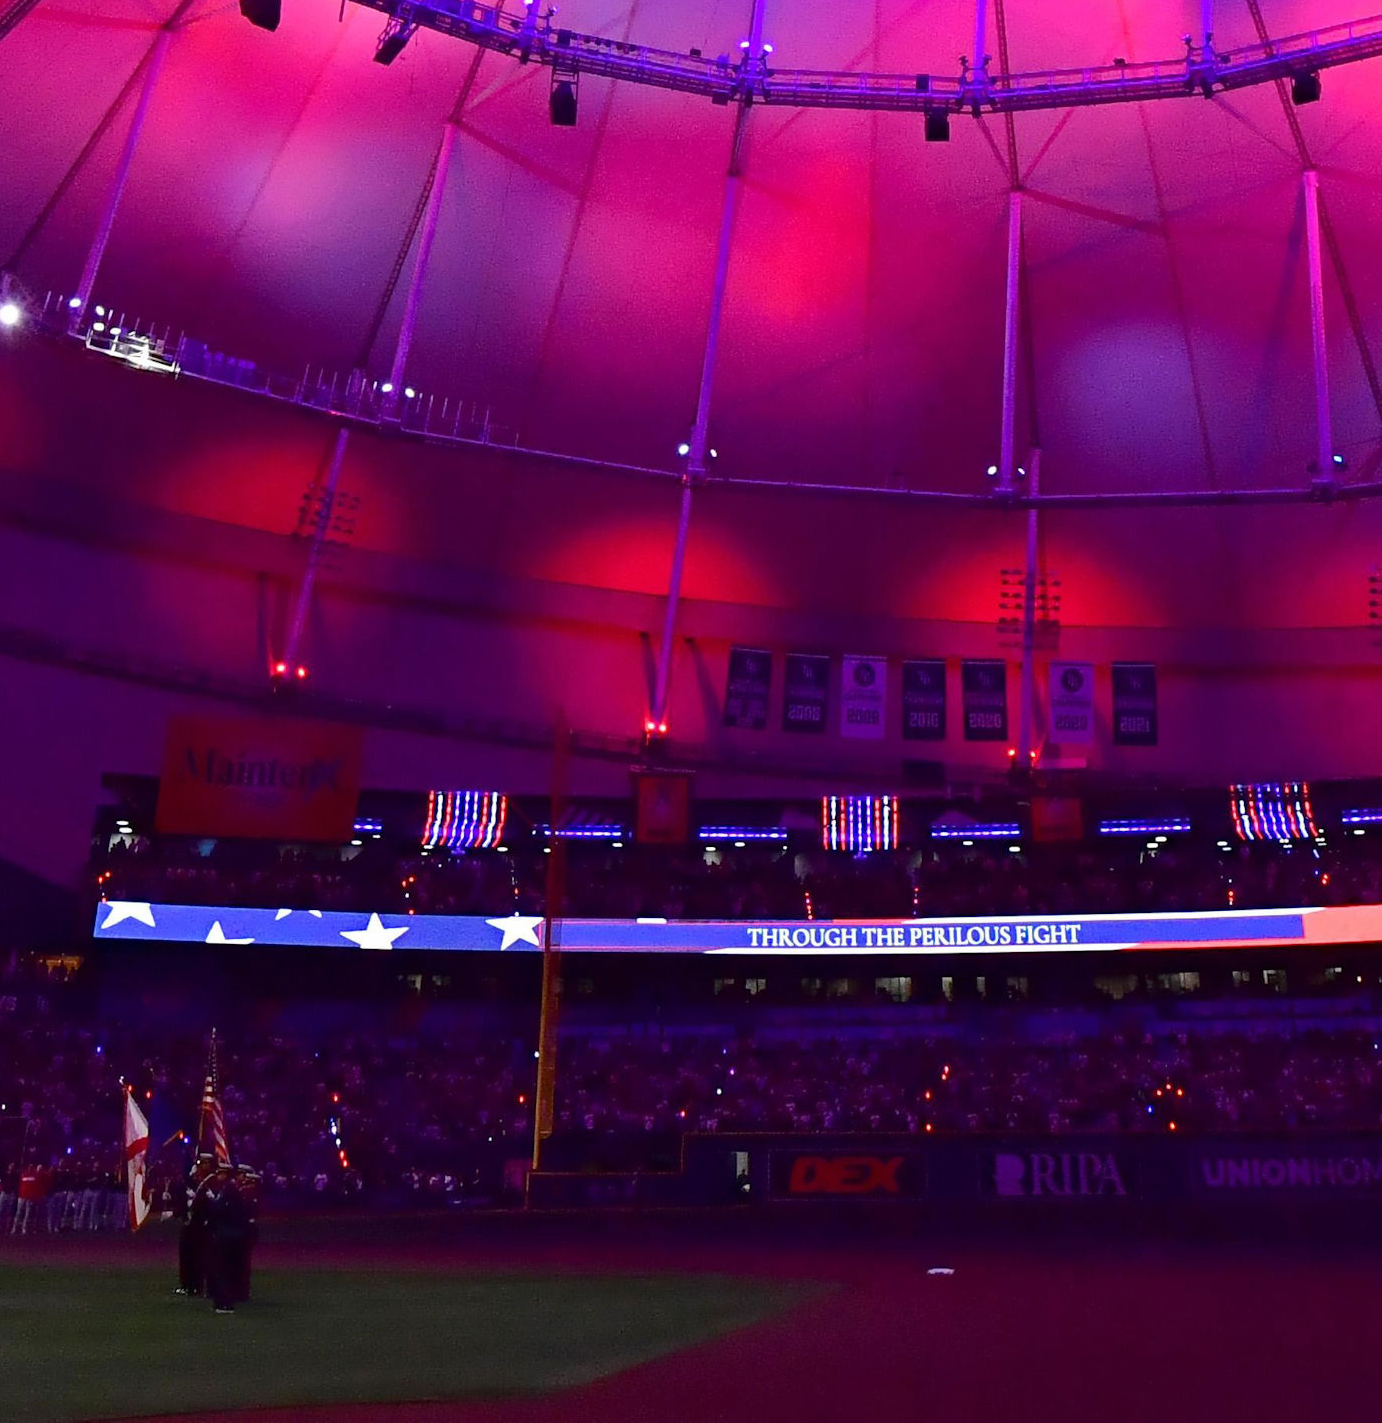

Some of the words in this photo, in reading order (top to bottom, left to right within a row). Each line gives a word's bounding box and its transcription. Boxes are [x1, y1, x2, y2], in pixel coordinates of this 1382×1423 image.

[747, 927, 857, 947] THROUGH
[862, 927, 905, 946] THE
[909, 925, 1011, 946] PERILOUS
[1015, 924, 1081, 945] FIGHT
[1029, 1153, 1127, 1195] RIPA
